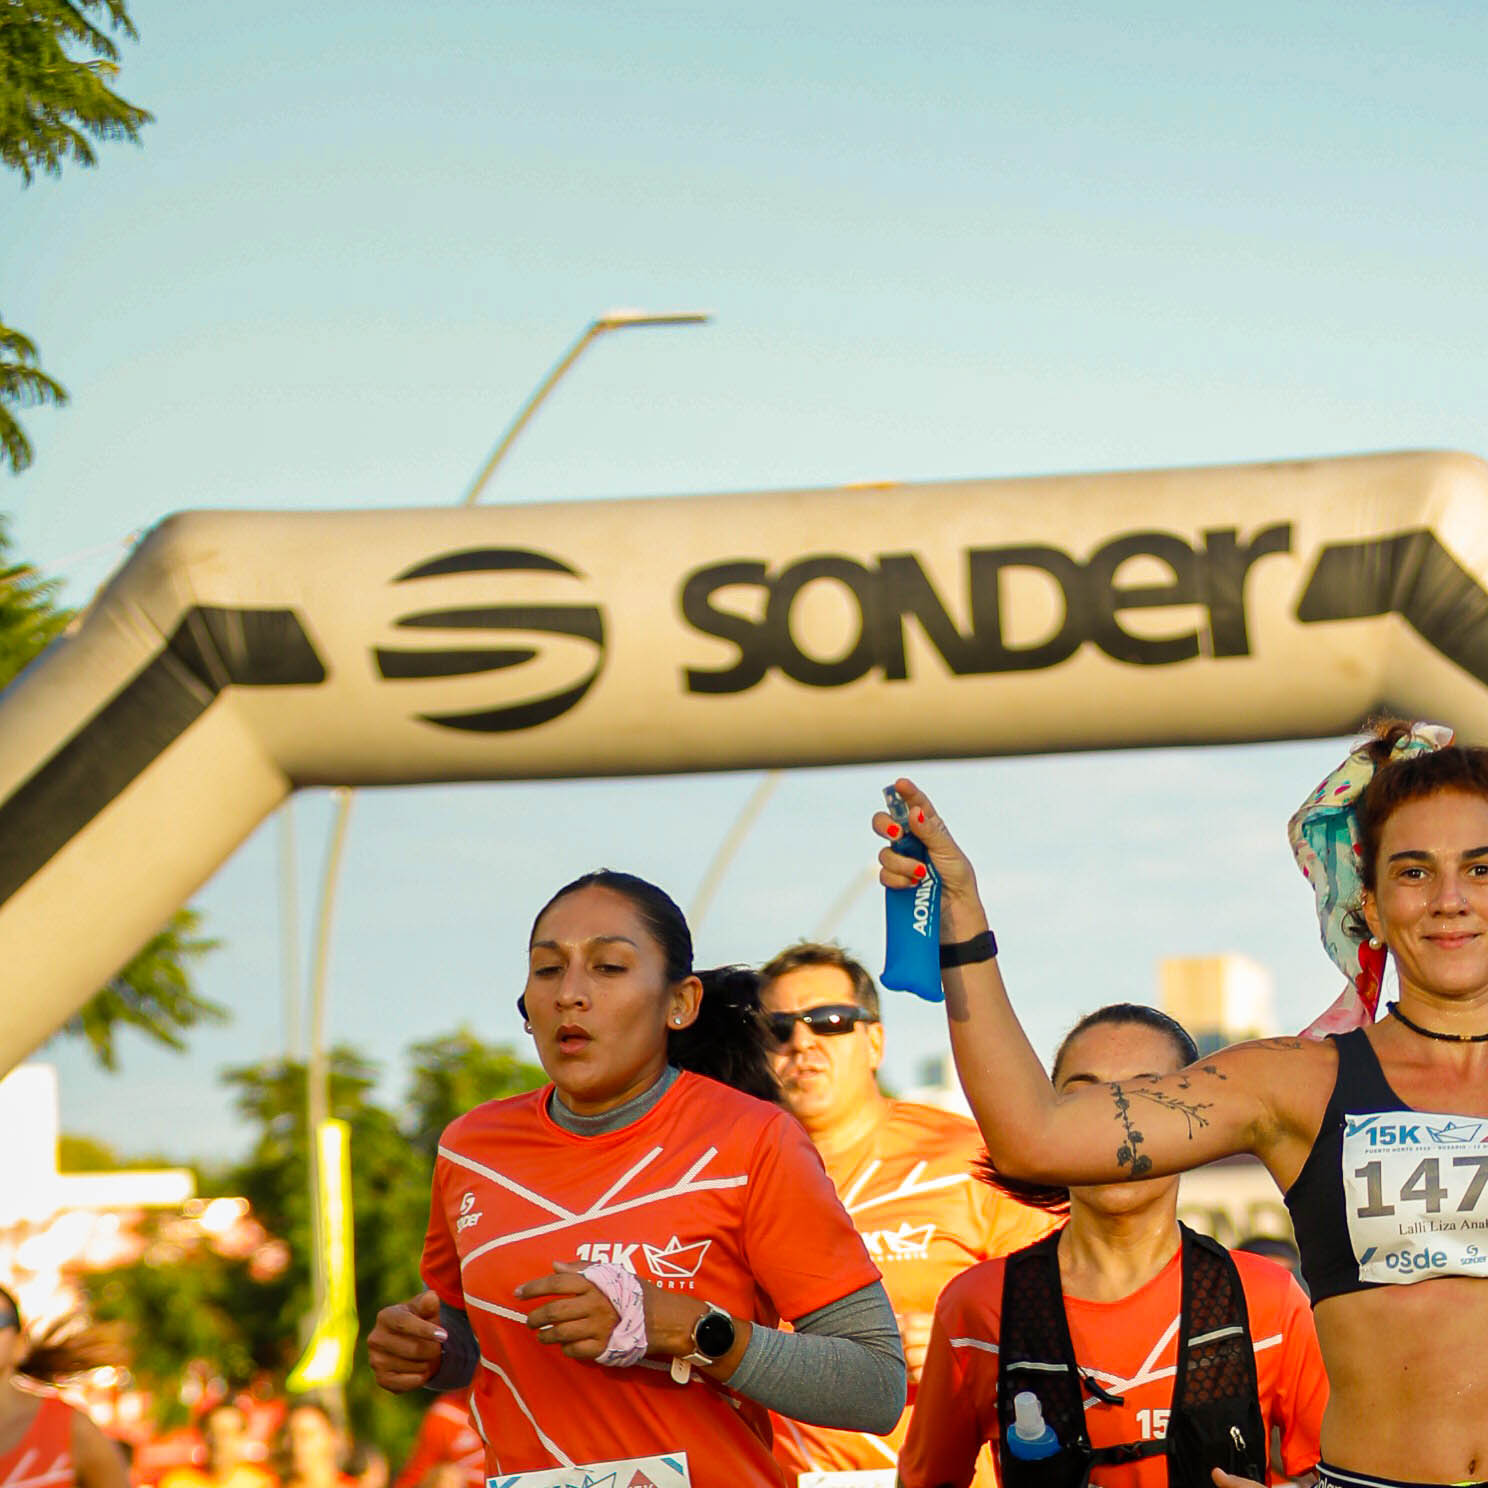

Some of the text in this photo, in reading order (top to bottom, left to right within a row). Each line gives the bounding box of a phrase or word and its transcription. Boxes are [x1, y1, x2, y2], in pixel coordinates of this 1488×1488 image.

[1365, 1125, 1421, 1146] 15K
[1399, 1222, 1427, 1236] Lalli
[1430, 1220, 1456, 1232] Liza
[1385, 1247, 1448, 1274] osde
[648, 1279, 695, 1290] ORTE
